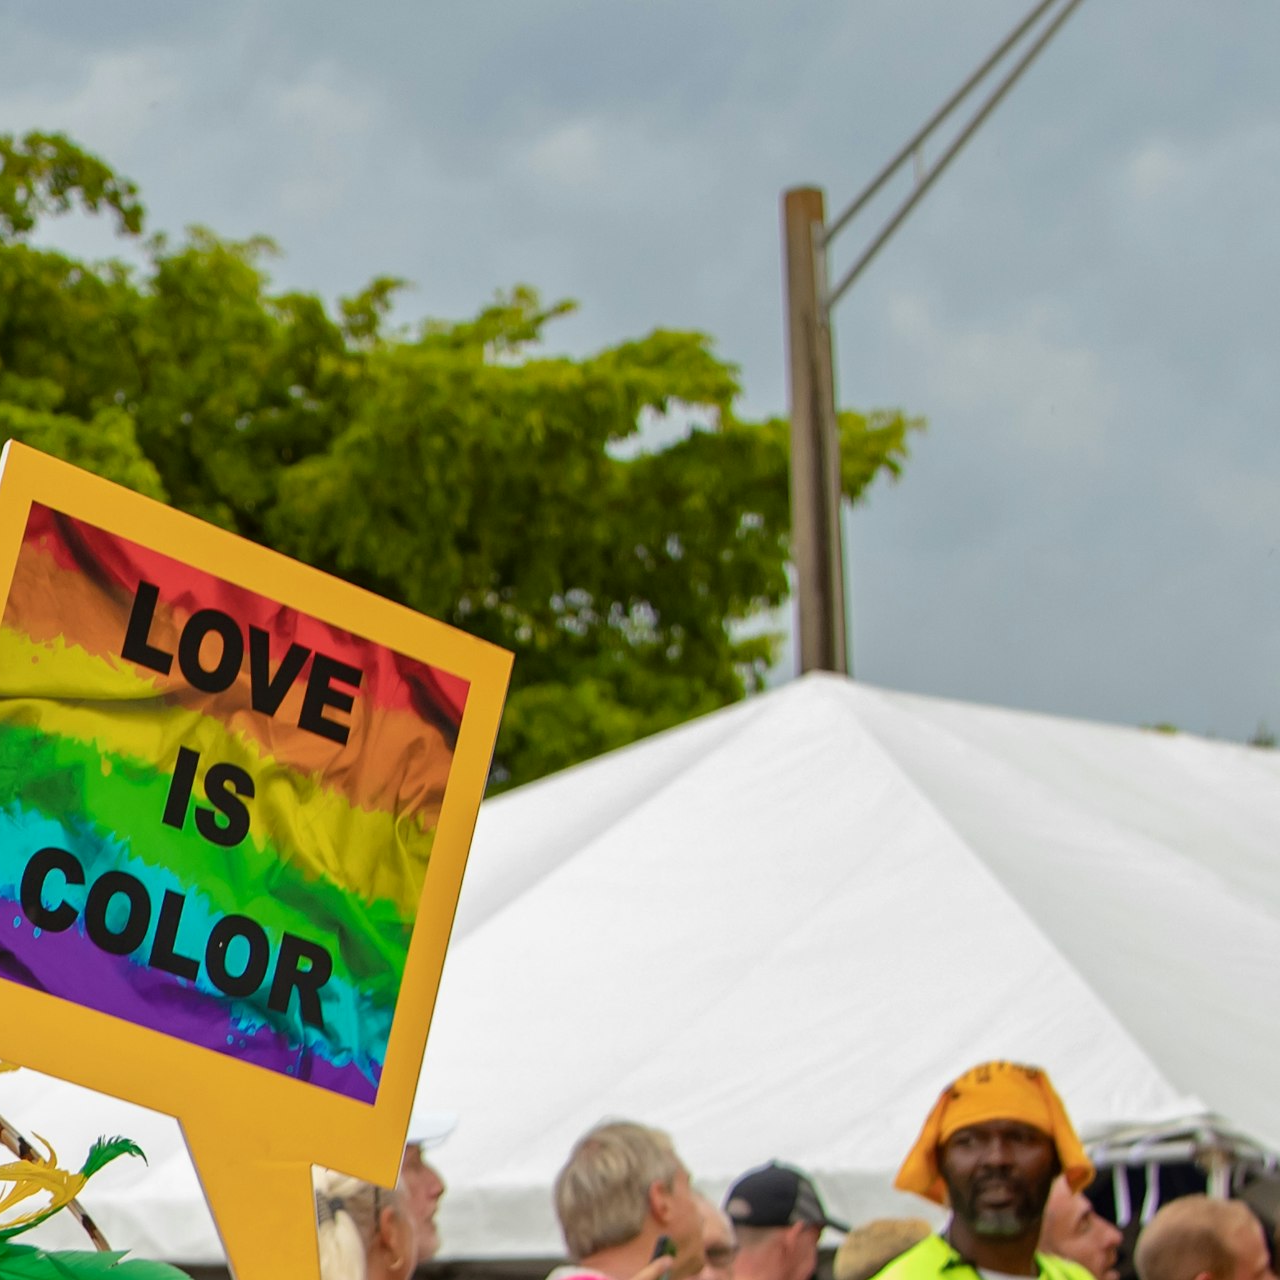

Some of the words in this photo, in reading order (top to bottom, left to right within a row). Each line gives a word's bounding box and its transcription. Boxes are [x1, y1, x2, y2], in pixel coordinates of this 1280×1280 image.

[121, 581, 363, 746] LOVE
[162, 746, 257, 848] IS
[20, 847, 333, 1029] COLOR
